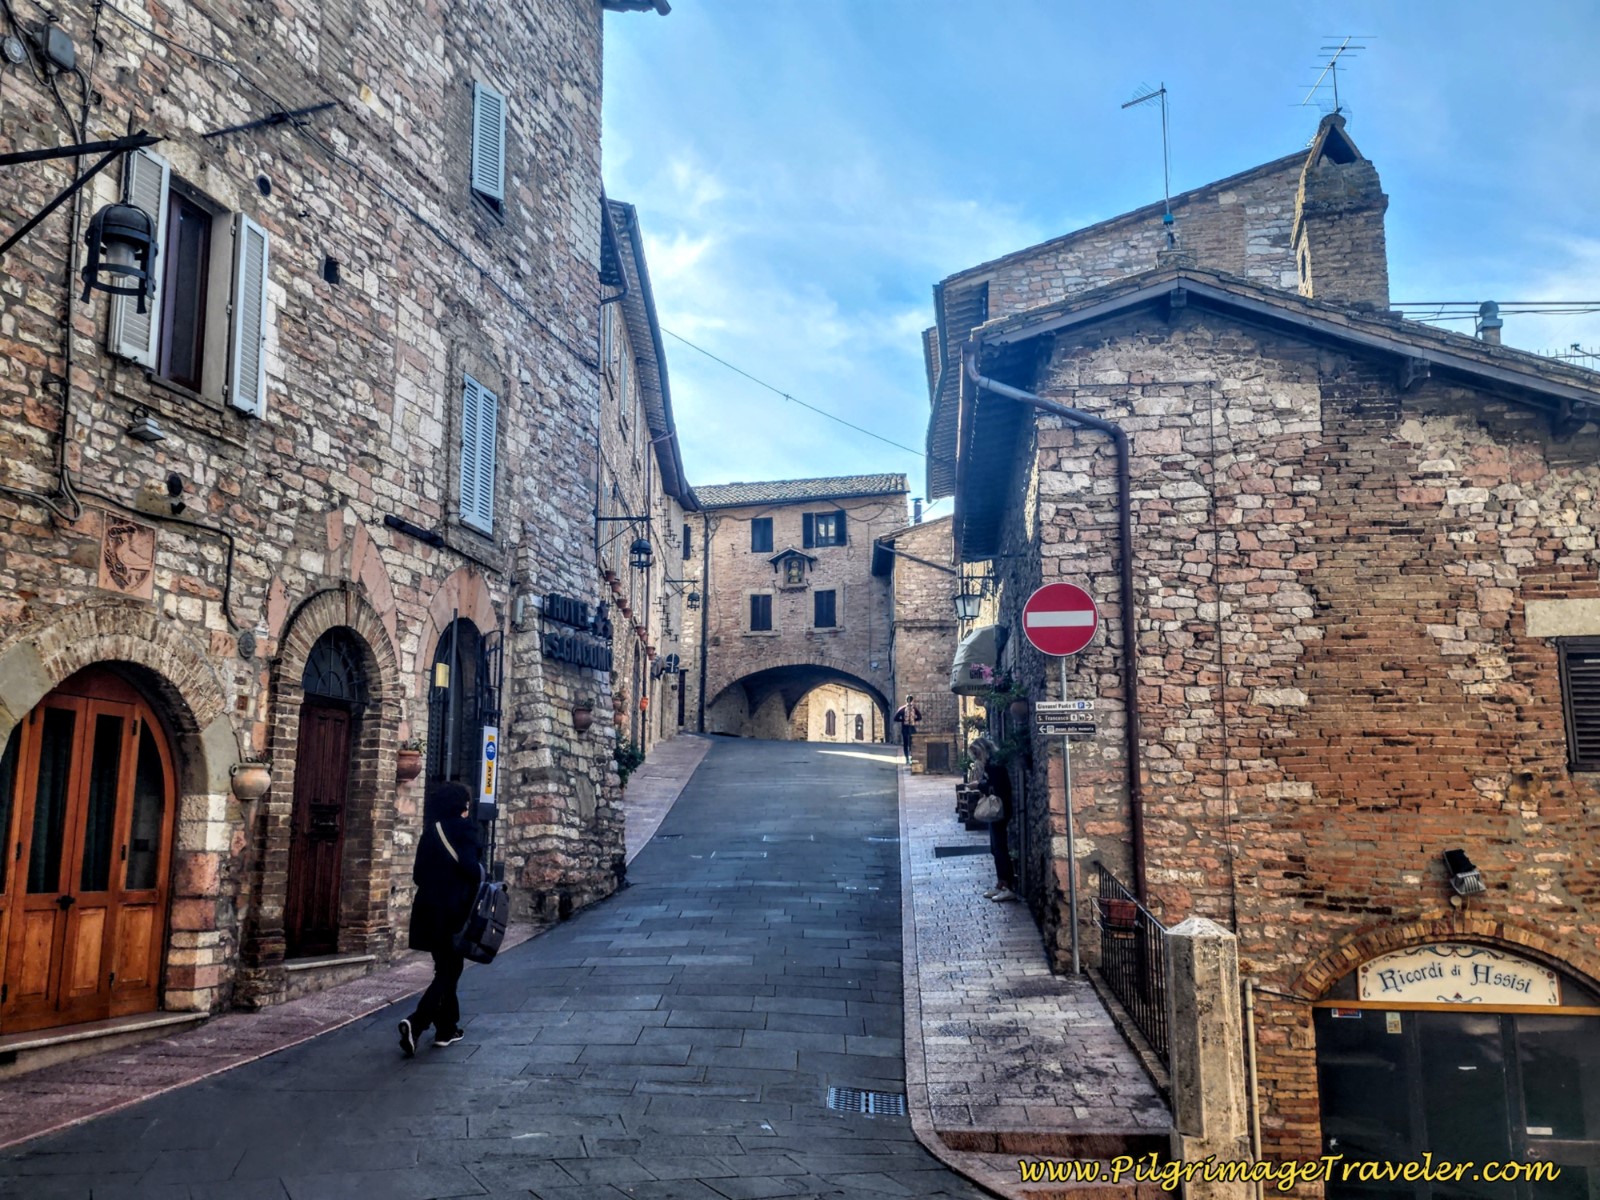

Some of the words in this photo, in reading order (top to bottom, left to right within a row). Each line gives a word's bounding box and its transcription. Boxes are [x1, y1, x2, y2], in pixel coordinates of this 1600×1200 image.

[1377, 962, 1444, 993] Ricordi
[1451, 965, 1461, 977] di
[1470, 962, 1533, 994] Assisi
